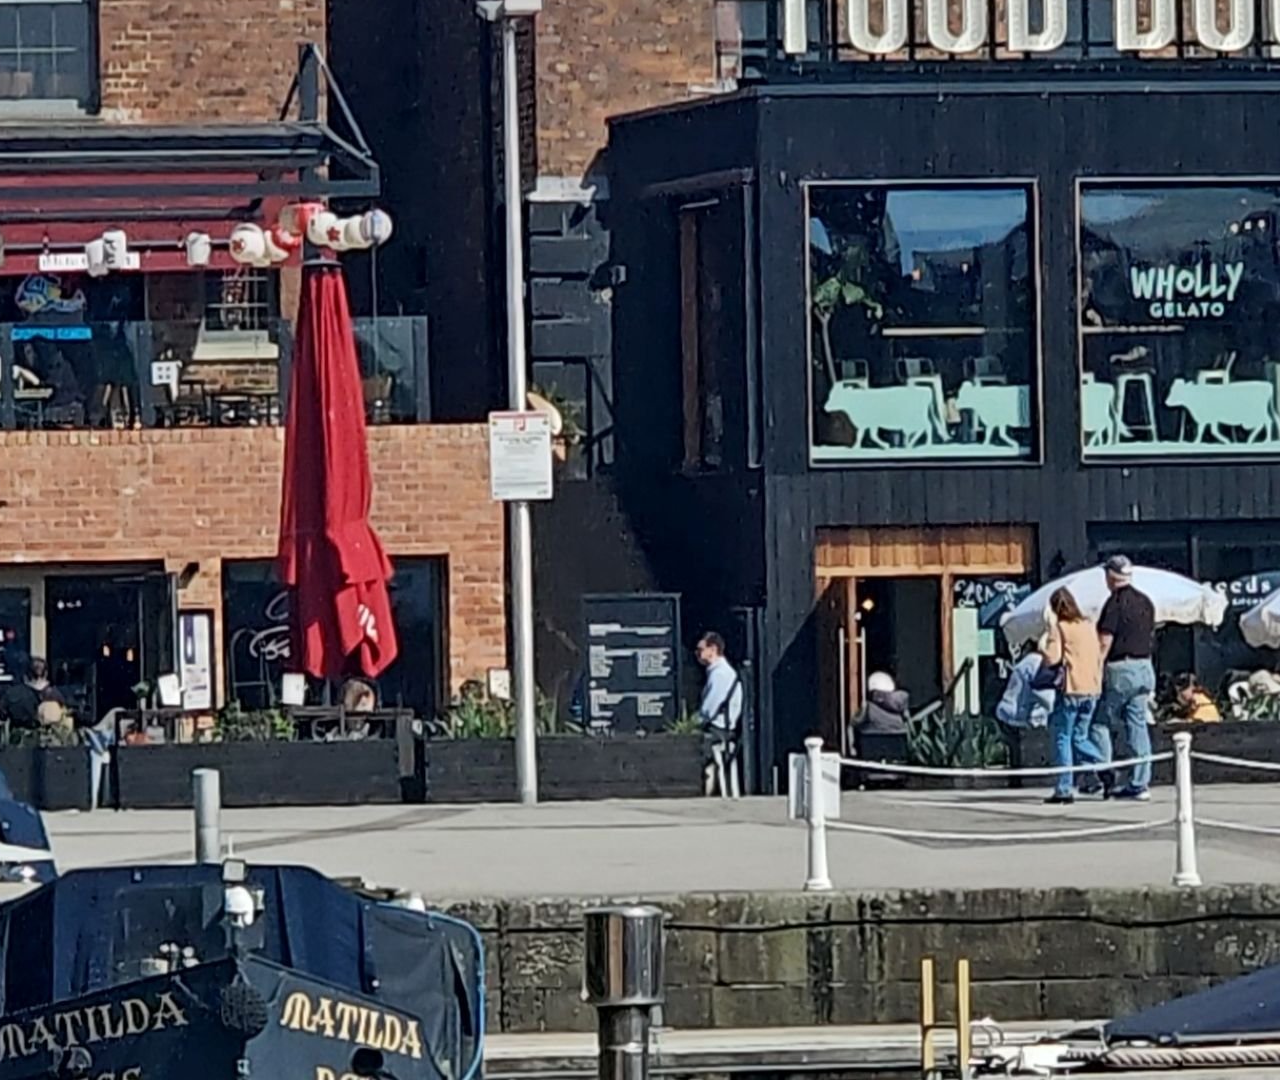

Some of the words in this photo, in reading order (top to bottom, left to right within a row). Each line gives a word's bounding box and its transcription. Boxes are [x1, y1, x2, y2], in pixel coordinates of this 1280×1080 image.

[1131, 261, 1244, 301] WHOLLY
[1149, 301, 1224, 318] GELATO
[1203, 575, 1272, 594] eeds
[284, 991, 422, 1059] MATILDA
